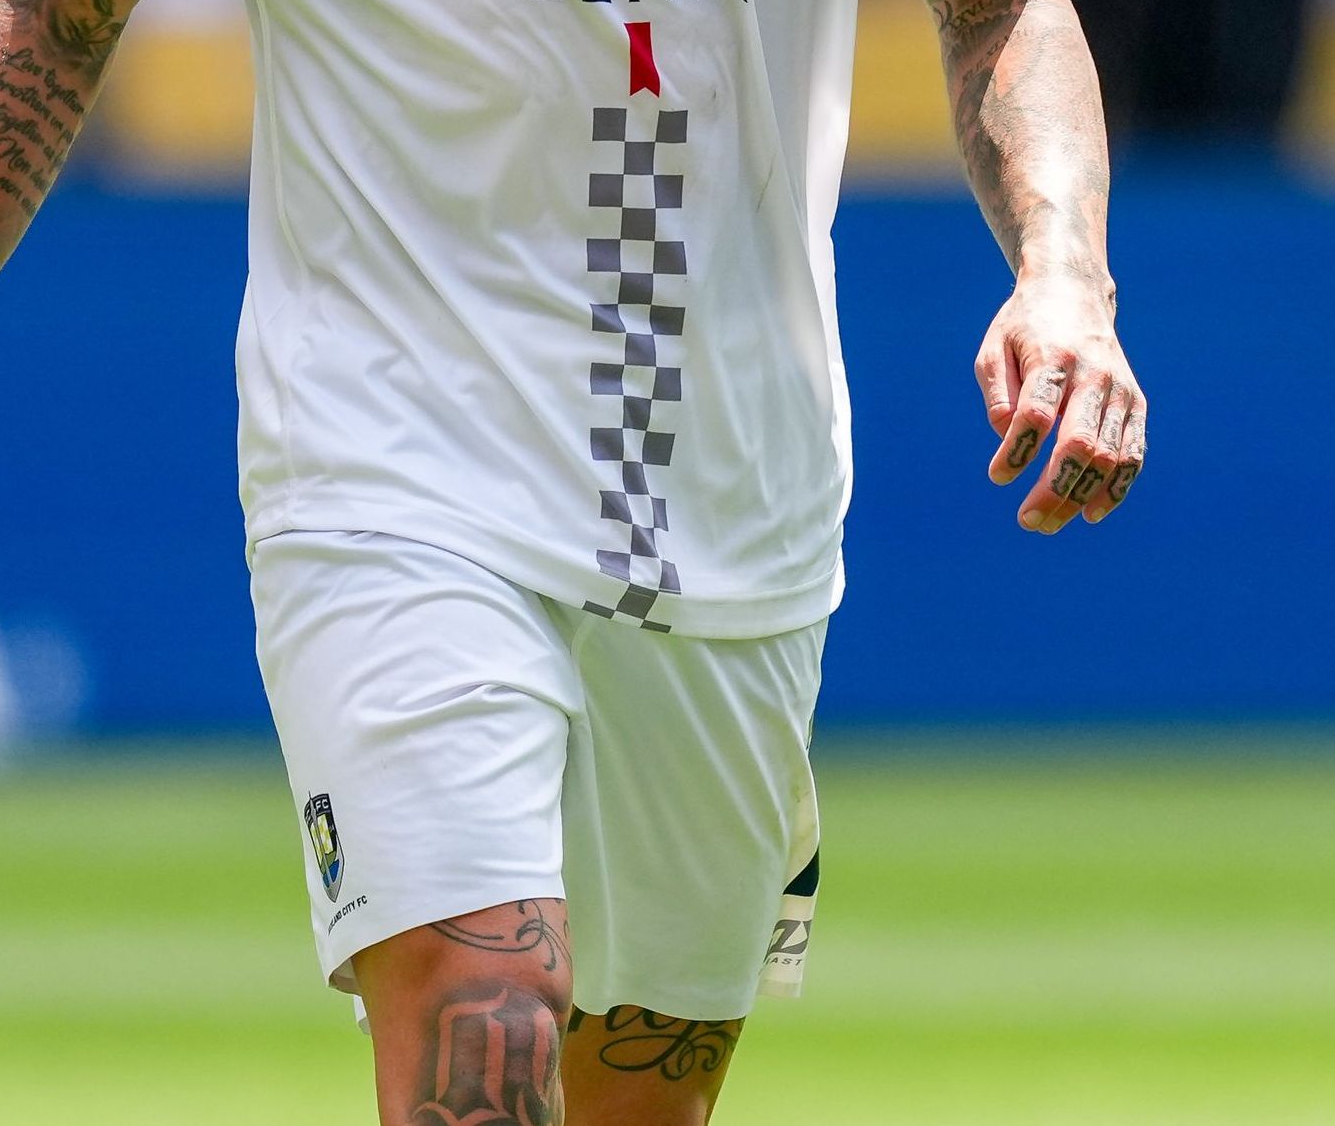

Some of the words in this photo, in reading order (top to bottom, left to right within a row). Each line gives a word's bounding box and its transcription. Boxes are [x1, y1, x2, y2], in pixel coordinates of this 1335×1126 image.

[315, 798, 330, 812] FC
[342, 900, 356, 916] CITY
[356, 894, 368, 908] FC
